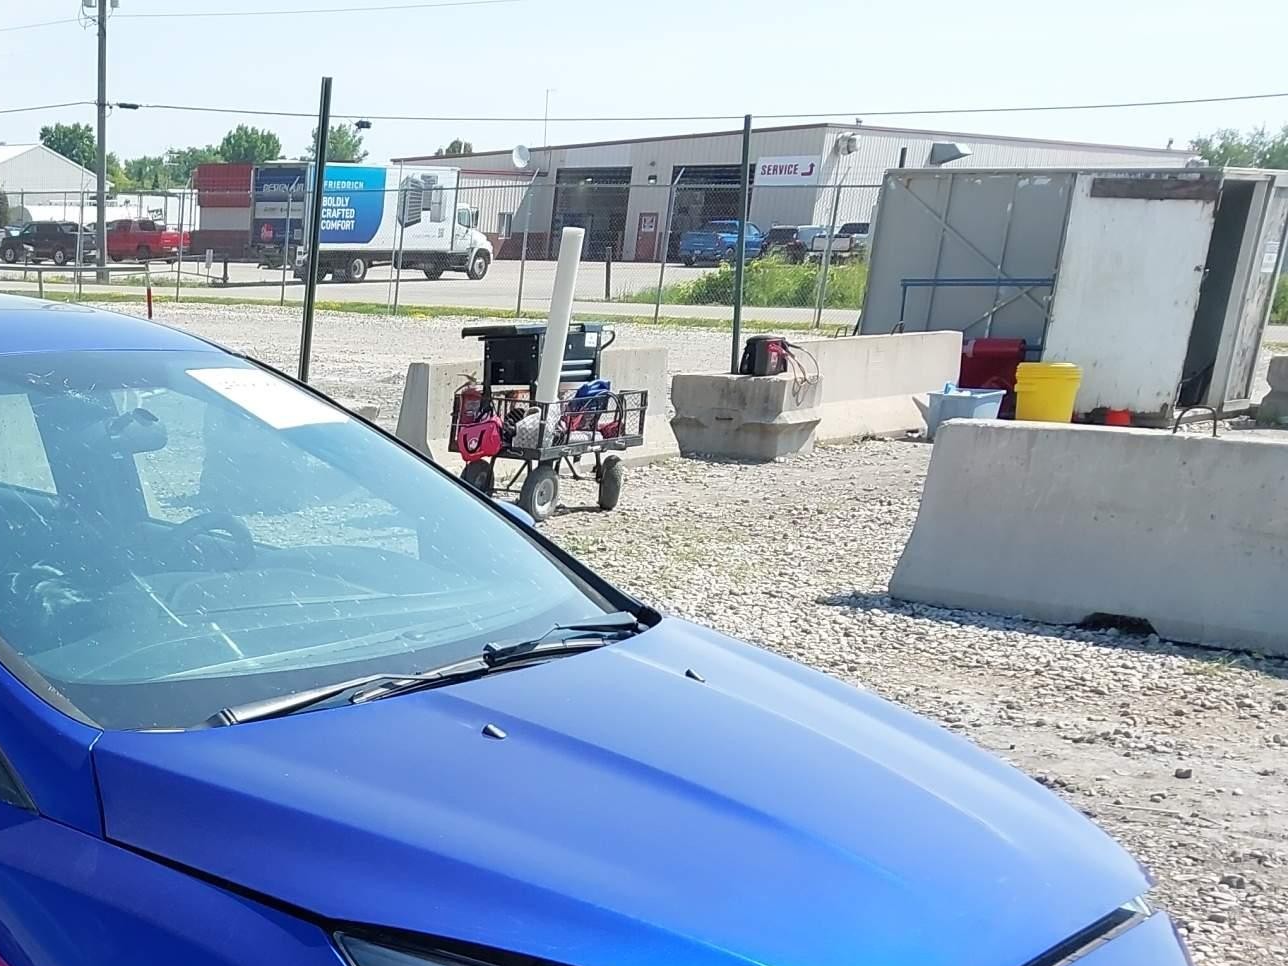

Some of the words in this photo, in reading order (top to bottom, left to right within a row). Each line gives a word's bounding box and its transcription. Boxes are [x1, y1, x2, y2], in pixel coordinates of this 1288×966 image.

[761, 164, 798, 175] SERVICE
[324, 180, 364, 189] FRIEDRICH
[322, 196, 350, 207] BOLDLY
[321, 208, 355, 219] CRAFTED
[321, 220, 356, 230] COMFORT
